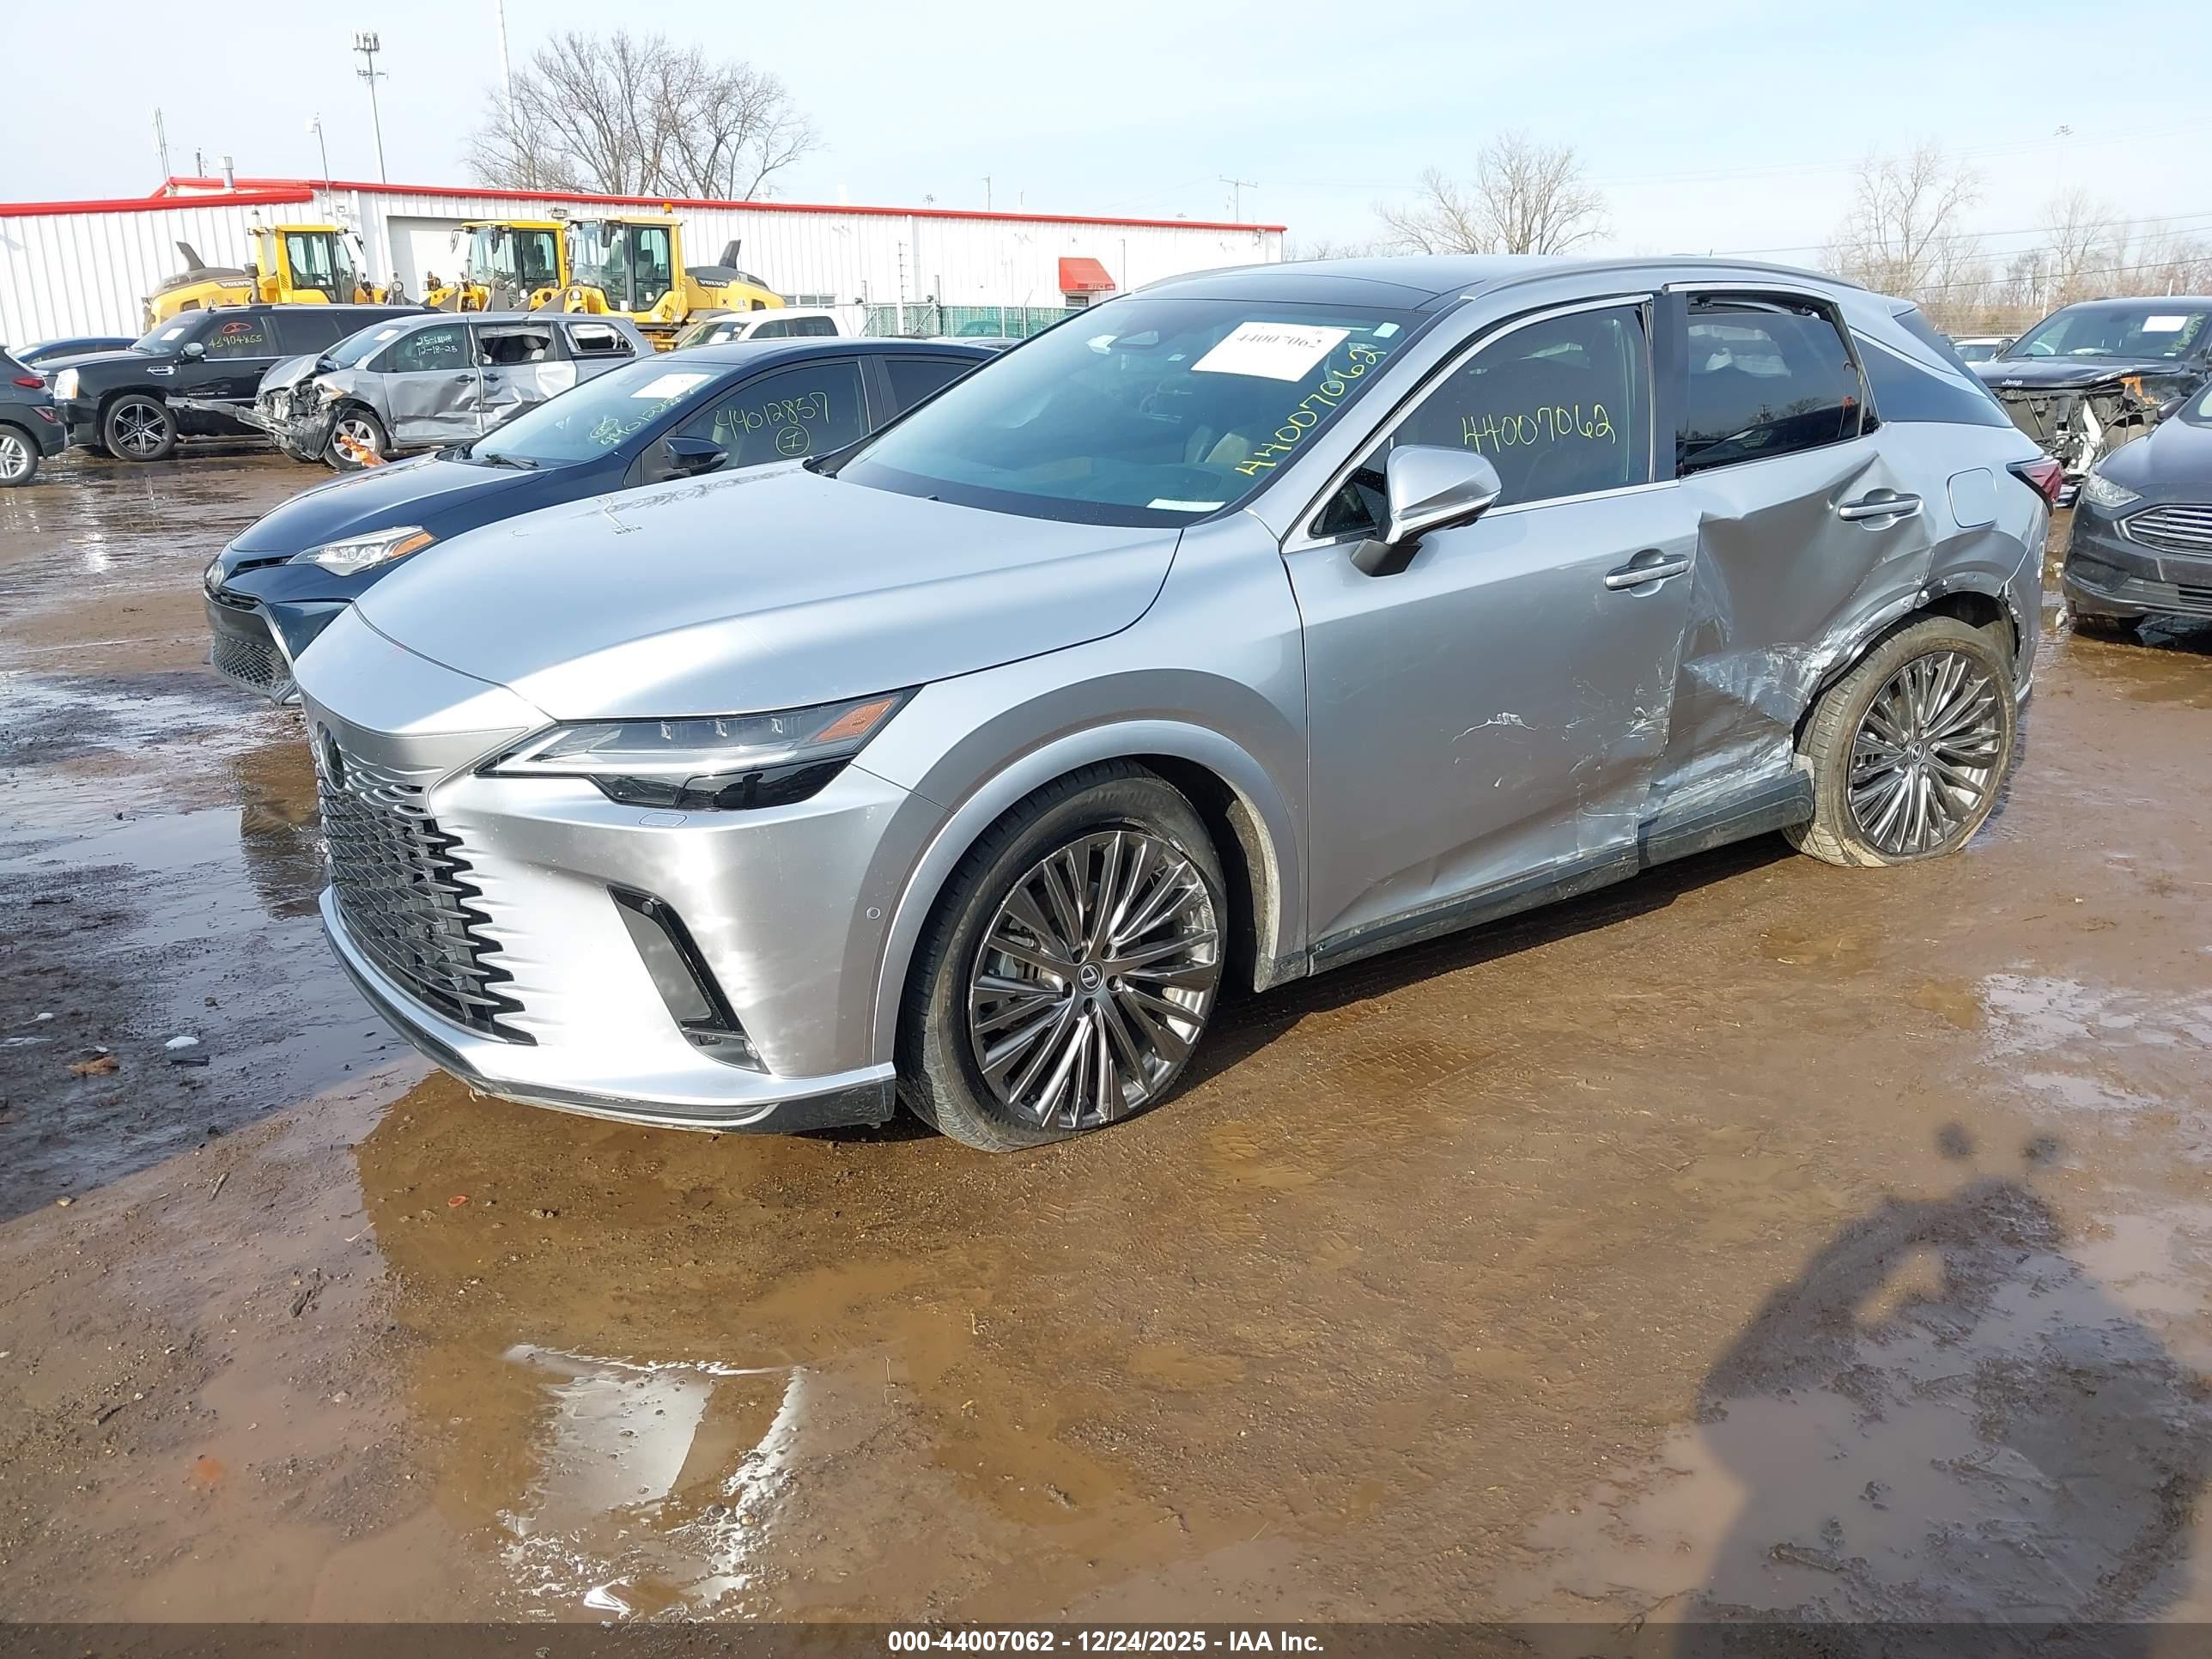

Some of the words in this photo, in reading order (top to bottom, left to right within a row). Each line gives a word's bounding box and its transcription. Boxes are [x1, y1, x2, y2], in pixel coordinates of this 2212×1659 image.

[417, 345, 458, 356] 12-18-25
[2001, 378, 2023, 386] Jeep
[714, 392, 830, 441] 44012857
[1235, 349, 1388, 476] 44007062
[1462, 404, 1616, 454] 44007062
